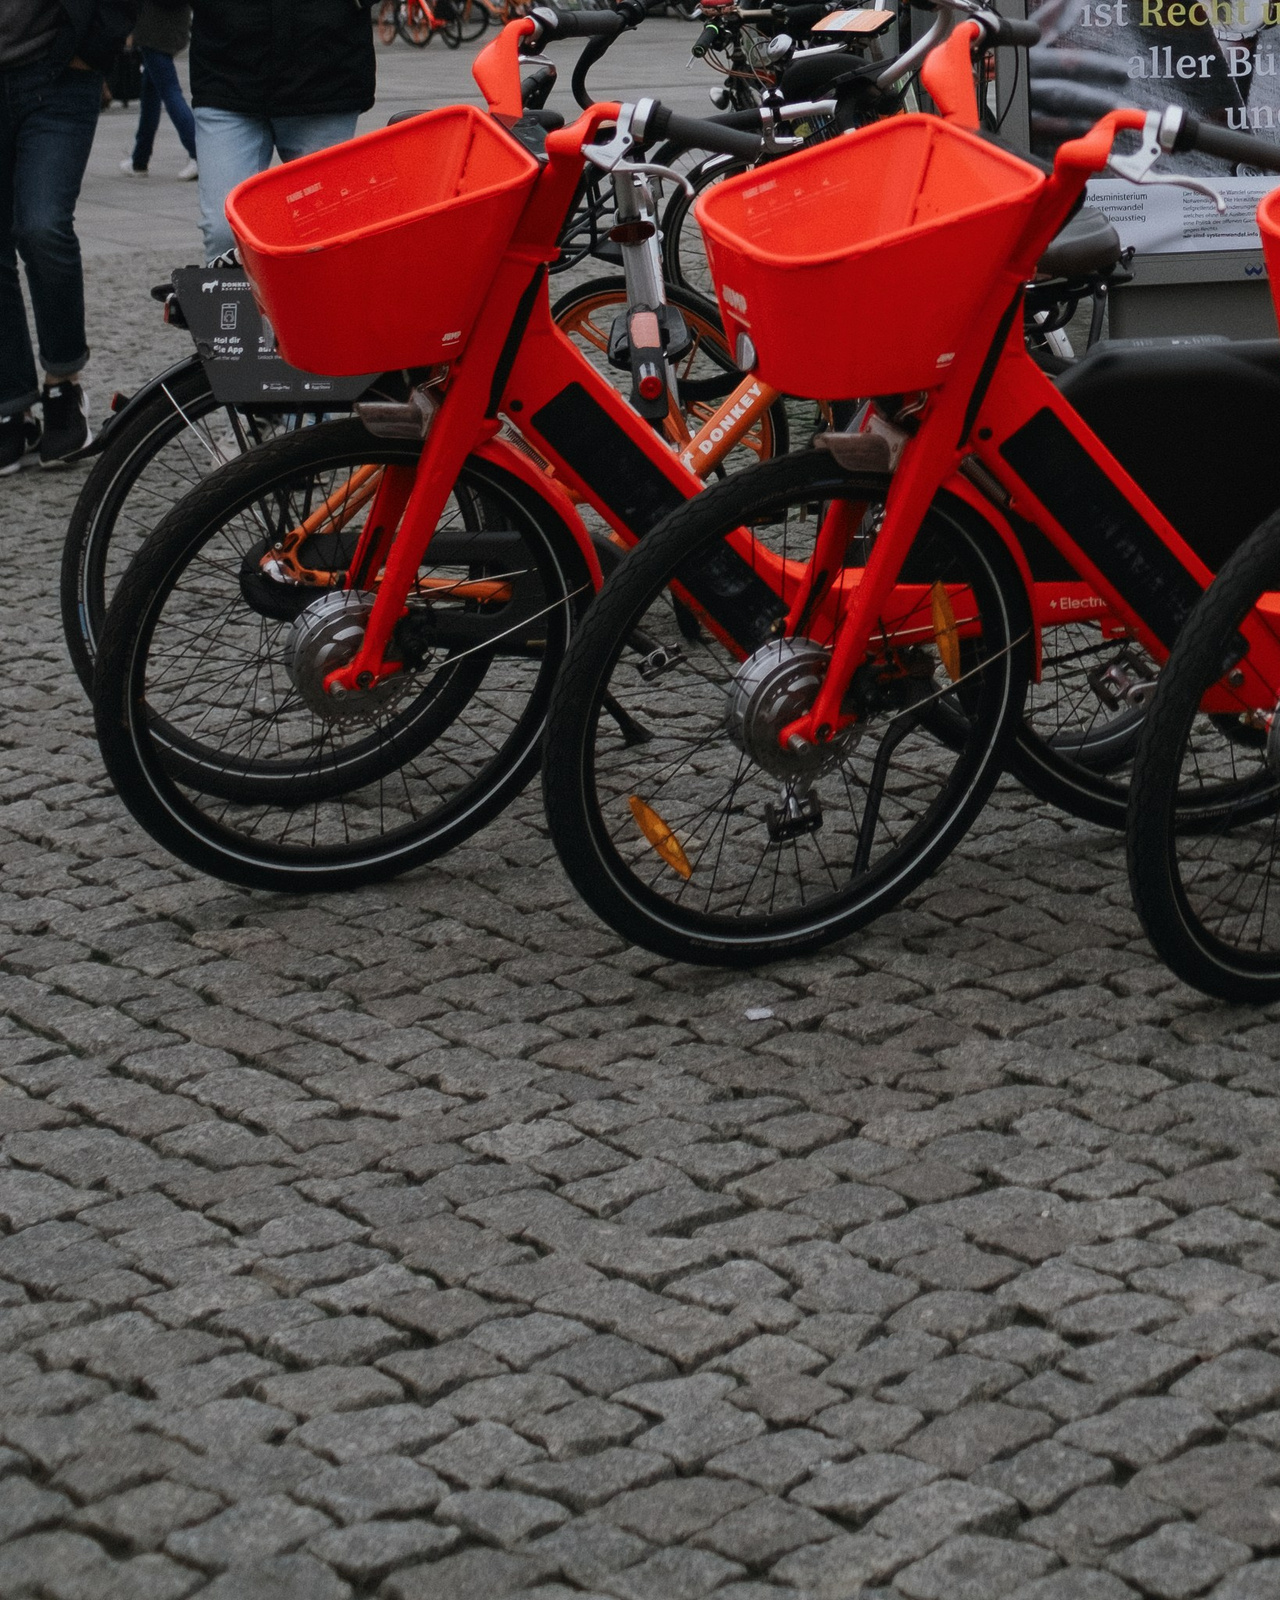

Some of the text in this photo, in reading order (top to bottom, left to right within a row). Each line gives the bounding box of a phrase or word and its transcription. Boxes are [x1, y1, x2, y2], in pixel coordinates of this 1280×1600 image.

[1127, 46, 1216, 79] aller
[227, 346, 243, 355] App
[699, 382, 763, 455] DONKEY
